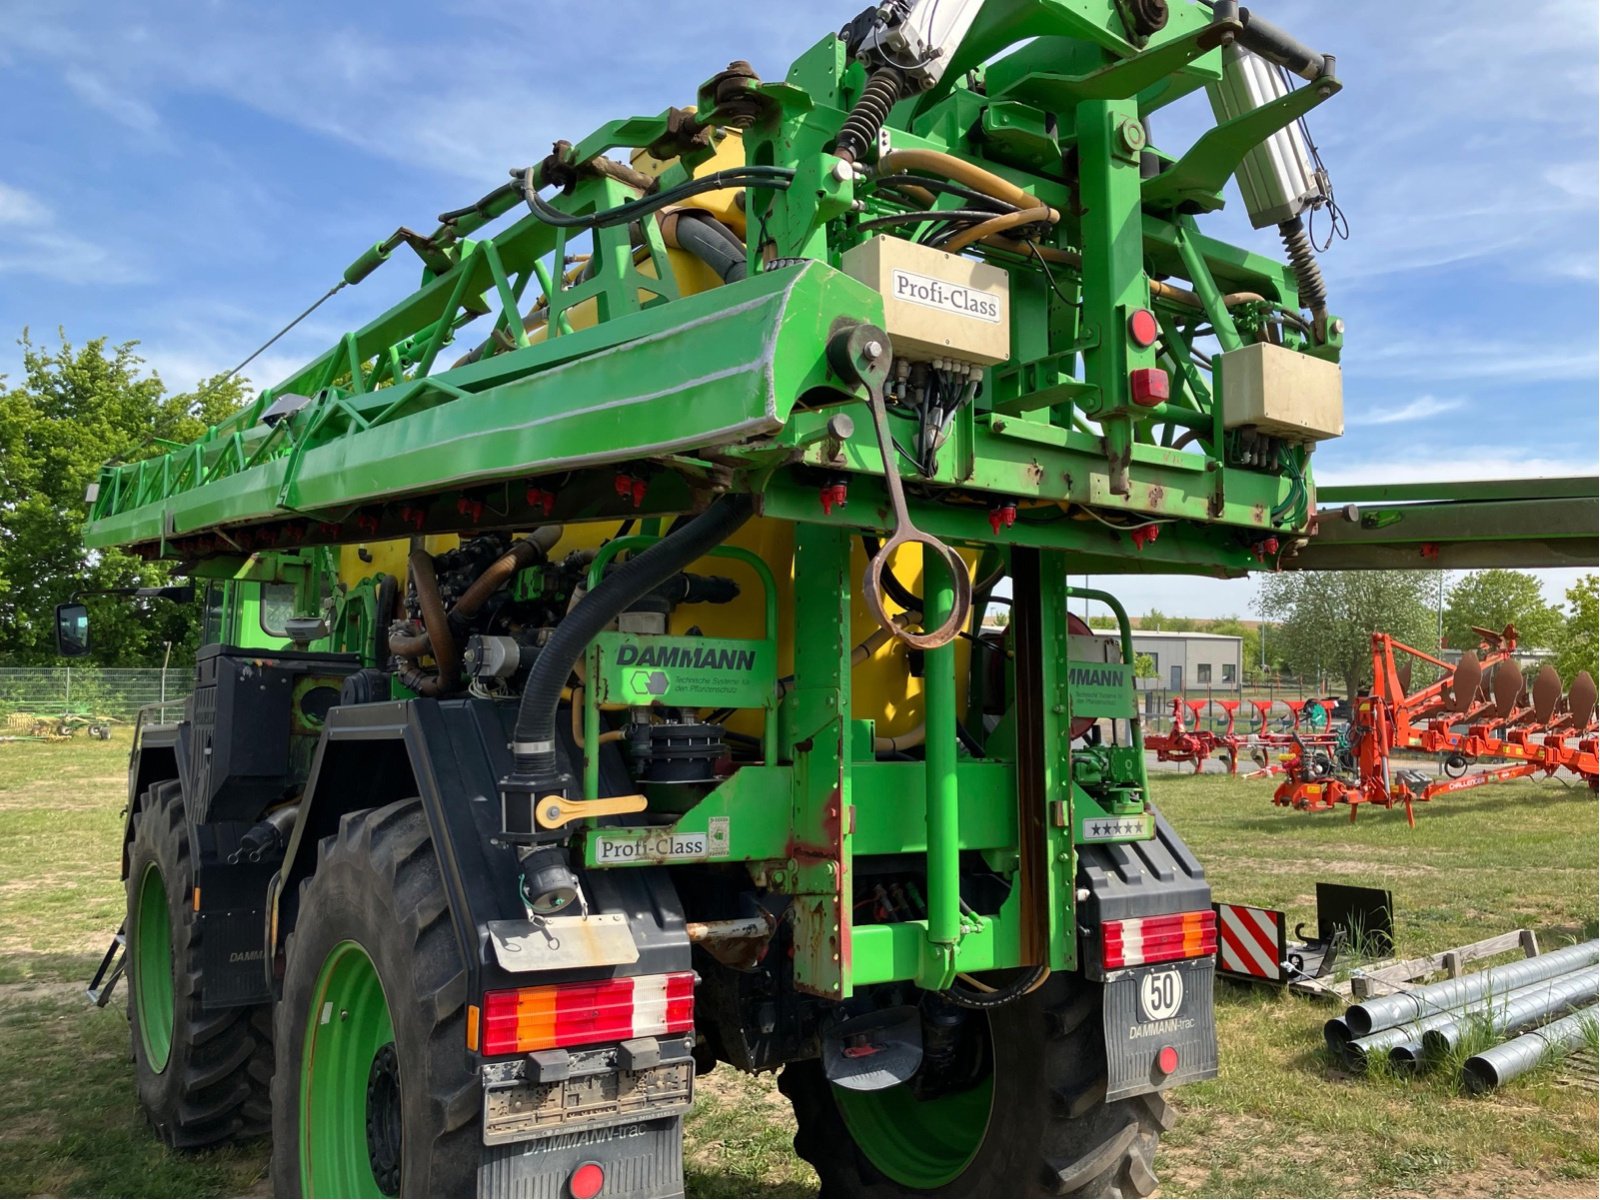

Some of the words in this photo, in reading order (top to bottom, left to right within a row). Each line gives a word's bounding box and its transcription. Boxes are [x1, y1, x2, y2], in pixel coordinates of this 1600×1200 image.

[897, 275, 997, 317] Profi-Class
[616, 643, 756, 671] DAMMANN
[601, 838, 703, 858] Profi-Class
[1150, 973, 1174, 1011] 50
[1129, 1017, 1196, 1040] DAMMANN-trac
[523, 1122, 648, 1157] DAMMANN-trac
